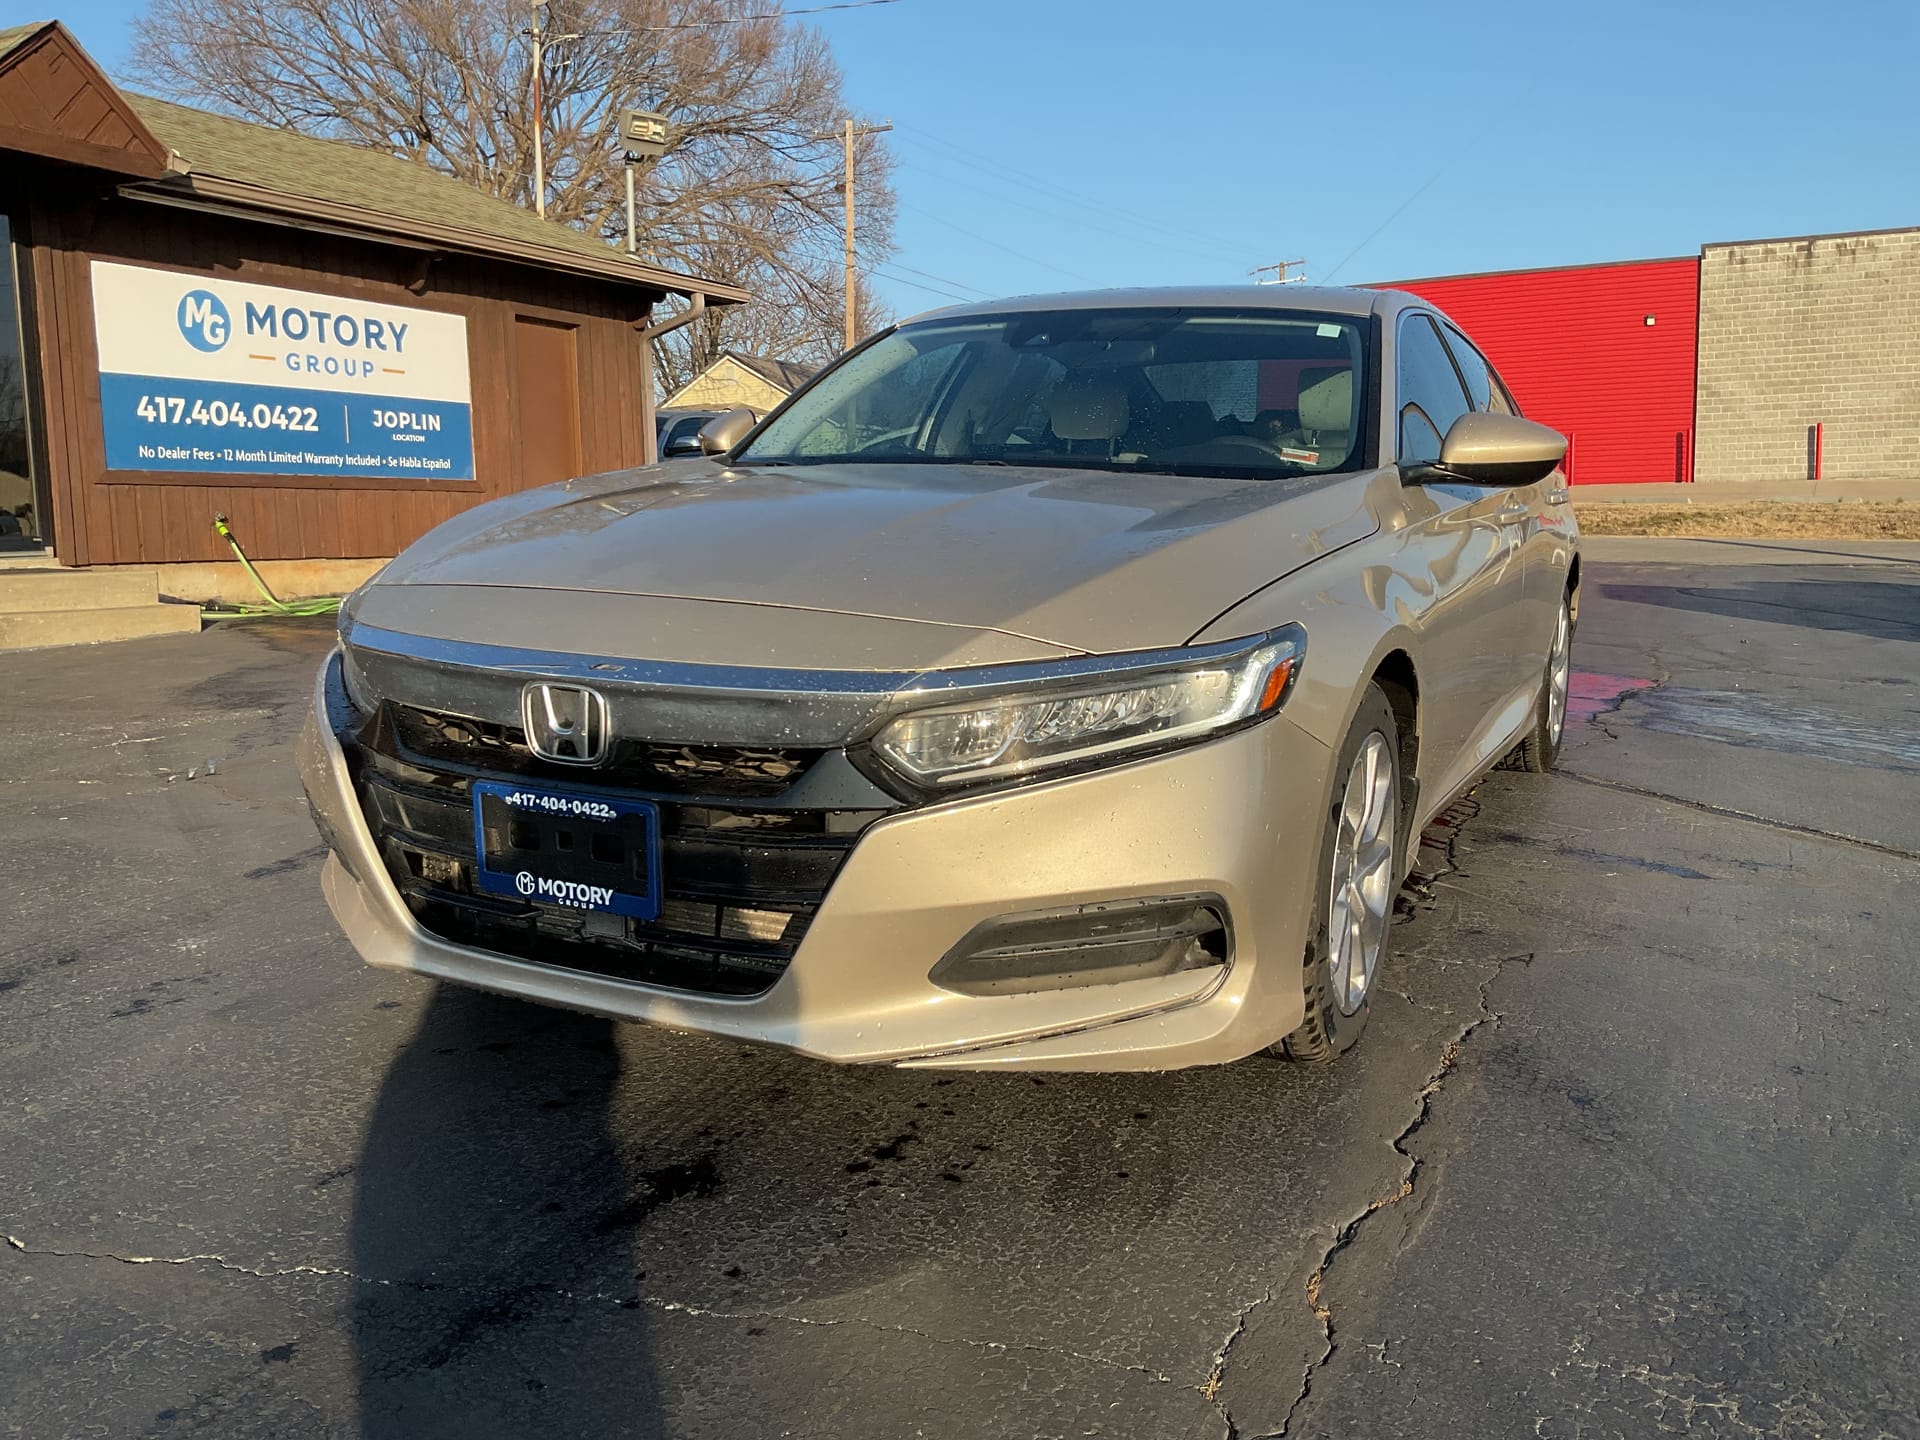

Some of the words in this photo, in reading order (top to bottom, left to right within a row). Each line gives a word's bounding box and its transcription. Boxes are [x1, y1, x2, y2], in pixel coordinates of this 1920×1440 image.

[245, 301, 408, 353] MOTORY
[285, 352, 374, 378] GROUP
[136, 395, 319, 431] 417.404.0422
[372, 410, 441, 432] JOPLIN
[392, 433, 425, 442] LOCATION
[139, 445, 155, 458] No
[157, 446, 190, 460] Dealer
[192, 447, 214, 461] Fees
[223, 449, 233, 461] 12
[235, 449, 267, 463] Month
[268, 451, 302, 464] Limited
[303, 452, 343, 468] Warranty
[345, 453, 380, 467] Included
[388, 455, 397, 468] Se
[399, 456, 421, 469] Habla
[423, 457, 450, 471] Español
[538, 877, 613, 906] MOTORY
[558, 898, 595, 910] GROUP
